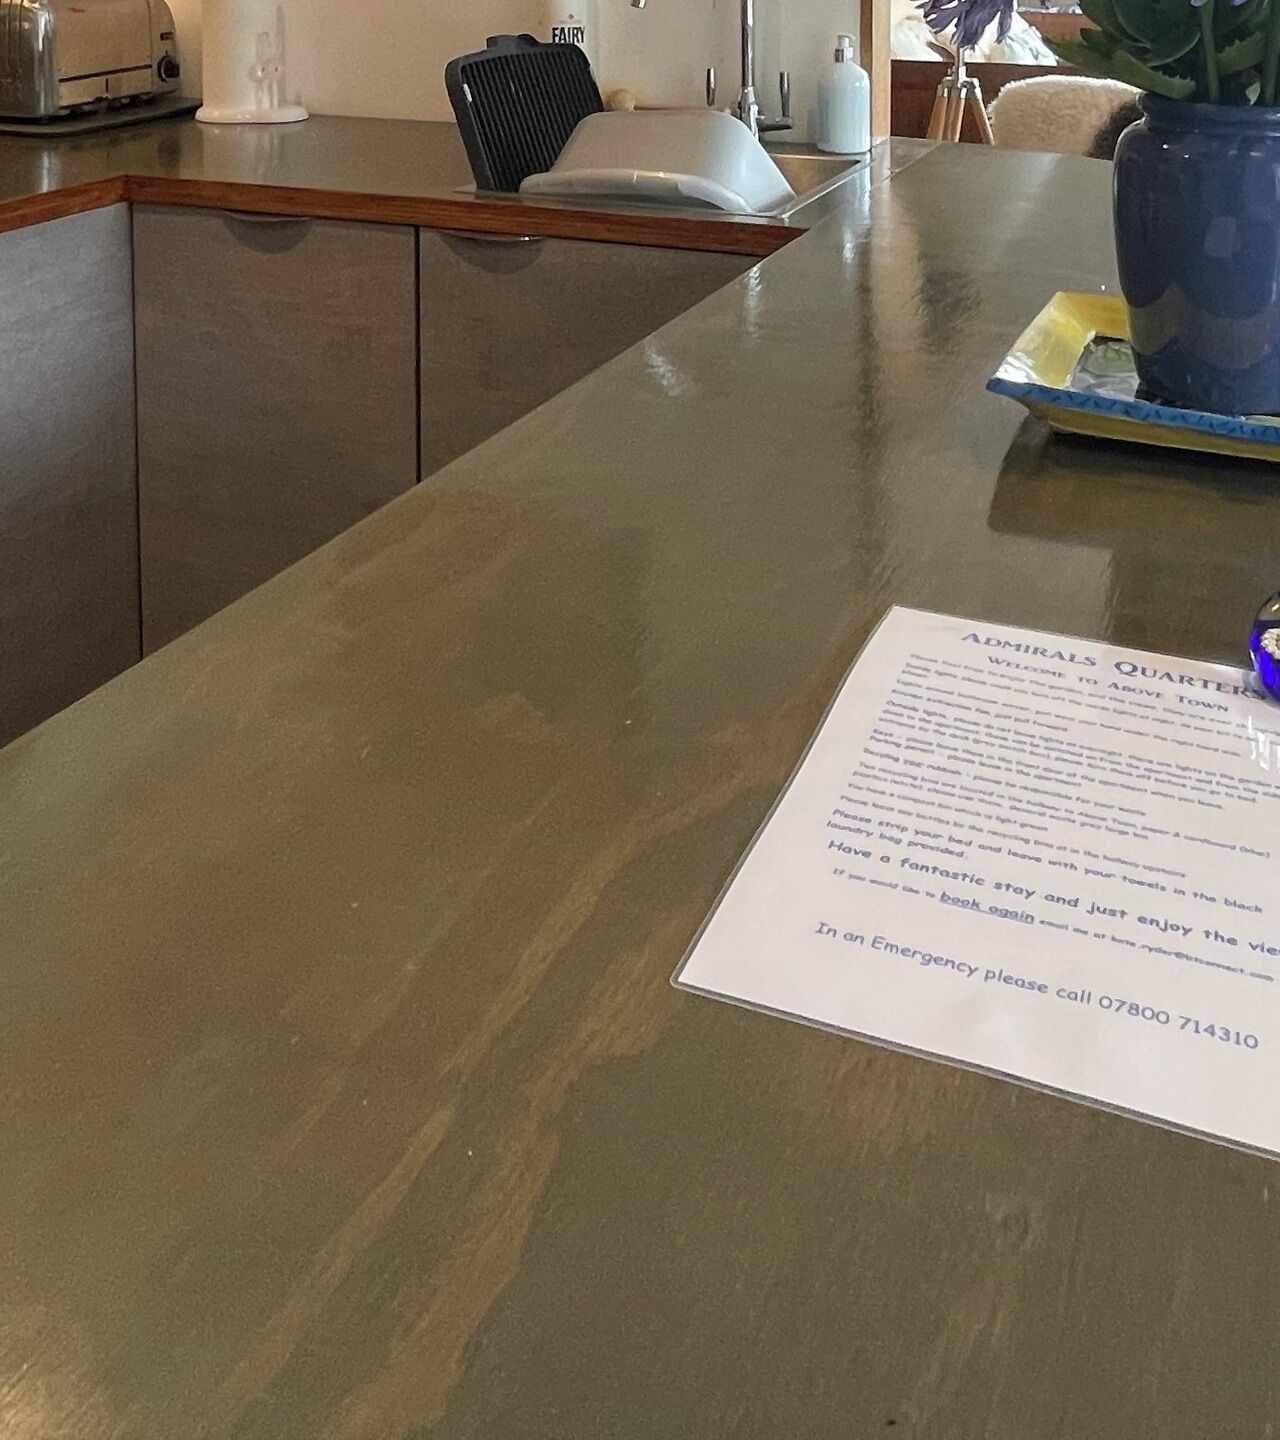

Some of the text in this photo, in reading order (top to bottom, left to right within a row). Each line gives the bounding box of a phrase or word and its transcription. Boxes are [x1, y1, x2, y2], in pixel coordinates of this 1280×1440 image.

[552, 26, 585, 44] FAIRY
[962, 633, 1096, 666] ADMIRALS
[988, 656, 1066, 678] WELCOME
[1078, 676, 1098, 685] TO
[1107, 682, 1163, 699] ABOVE
[1177, 695, 1229, 712] TOWN
[826, 820, 874, 838] laundry
[878, 832, 903, 846] bag
[832, 808, 1263, 914] Please strip your bed and leave with your towels in the black
[828, 840, 872, 859] Have
[879, 855, 891, 864] a
[900, 857, 985, 886] fantastic
[993, 882, 1036, 900] stay
[1044, 894, 1080, 908] and
[1086, 901, 1128, 920] just
[1137, 916, 1193, 937] enjoy
[1203, 929, 1238, 946] the
[939, 891, 981, 912] book
[986, 905, 1035, 925] again
[814, 921, 1259, 1049] In an Emergency please call 07800 714310
